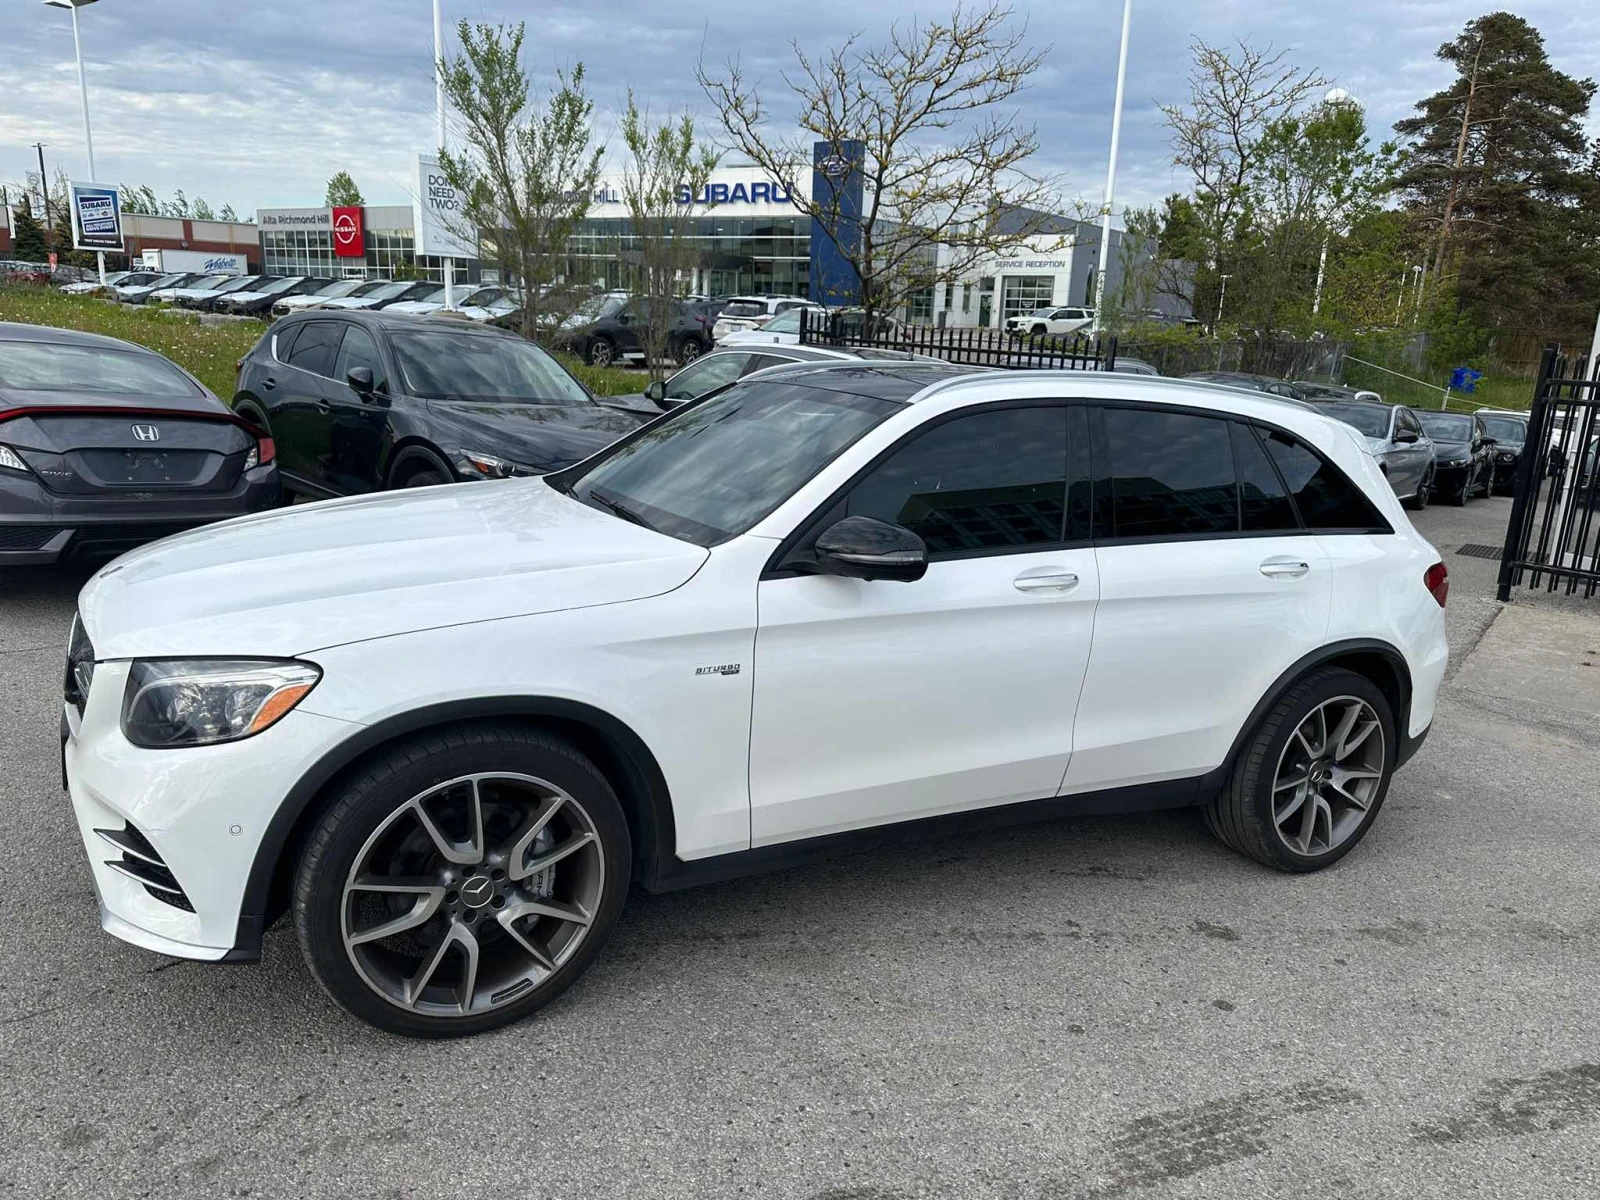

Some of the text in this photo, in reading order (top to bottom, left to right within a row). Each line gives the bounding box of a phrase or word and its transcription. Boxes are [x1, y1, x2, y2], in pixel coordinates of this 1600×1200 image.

[428, 186, 455, 199] NEED
[594, 189, 619, 203] HILL
[673, 182, 794, 204] SUBARU
[80, 201, 111, 209] SUBARU
[429, 197, 459, 211] TWO?
[263, 213, 329, 225] Alta Richmond Hill
[994, 260, 1066, 268] SERVICE RECEPTION
[695, 663, 741, 675] BITURBO
